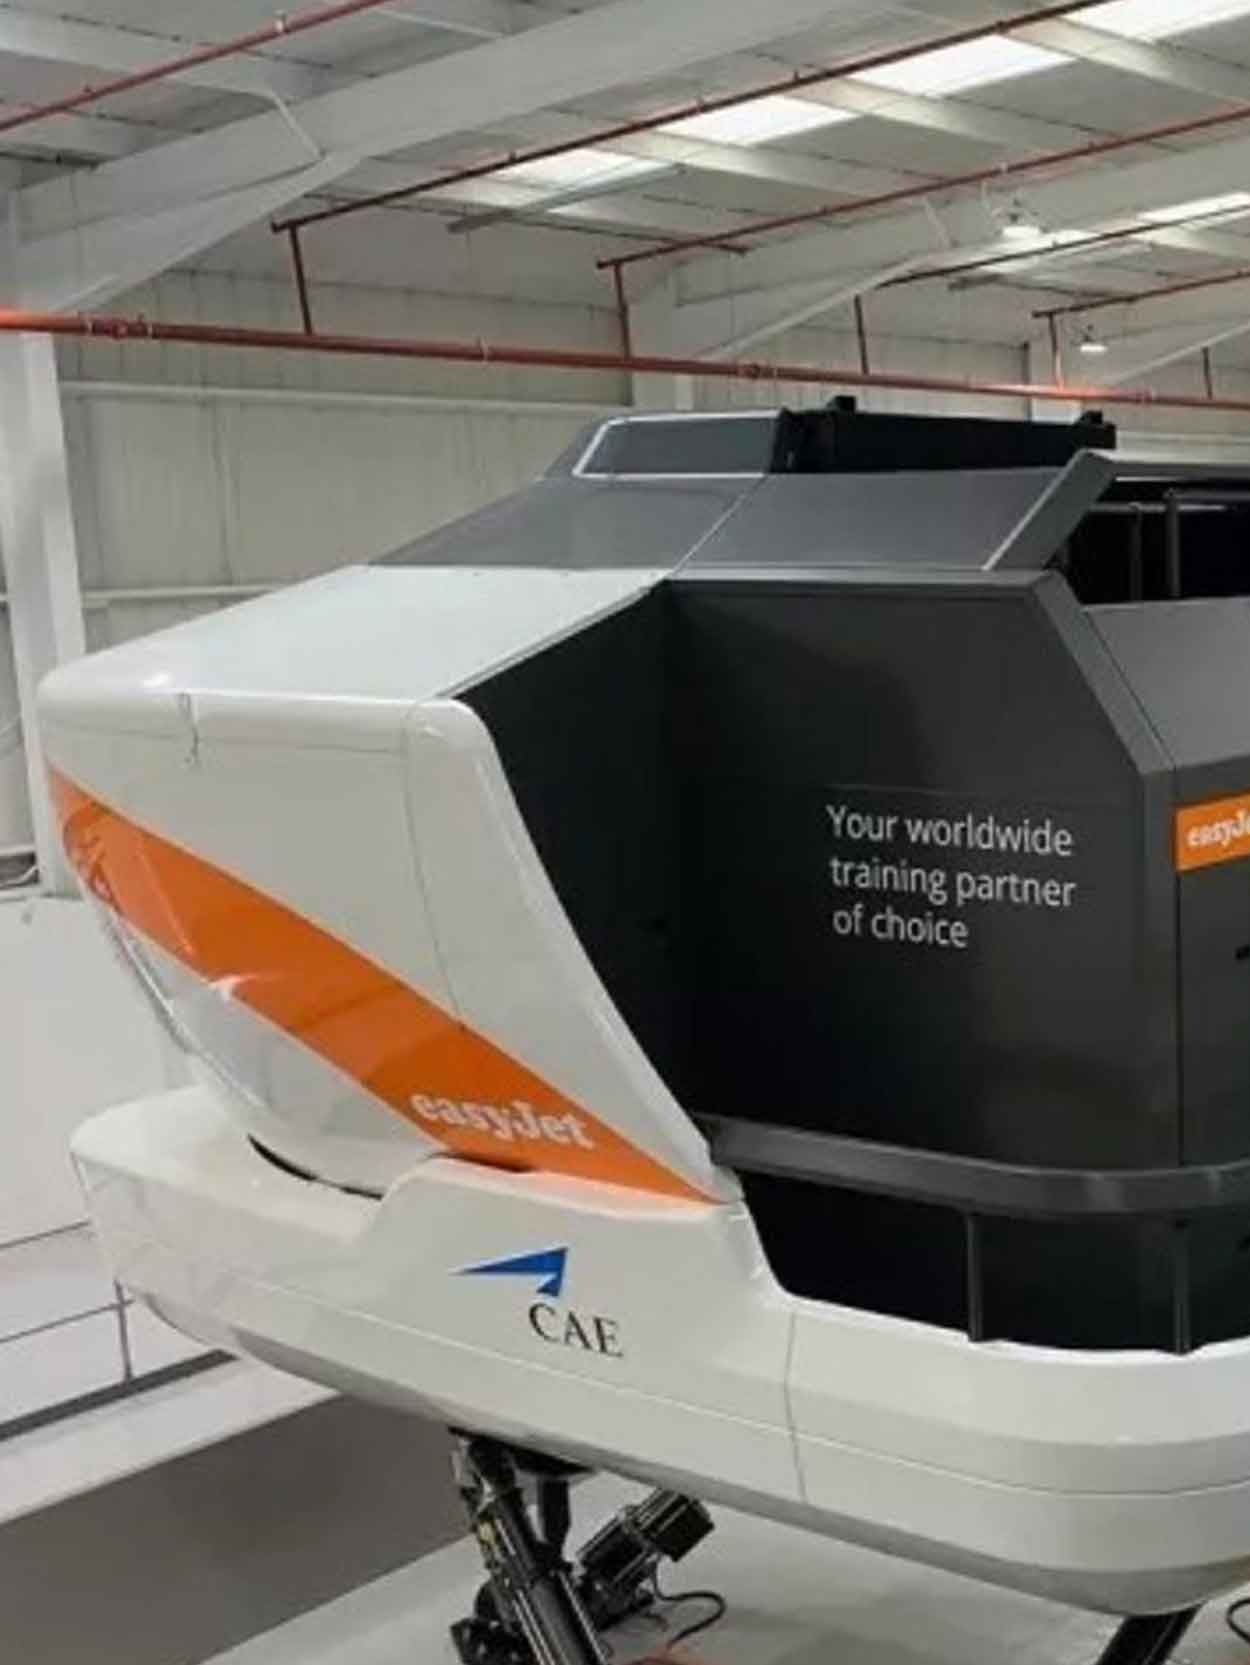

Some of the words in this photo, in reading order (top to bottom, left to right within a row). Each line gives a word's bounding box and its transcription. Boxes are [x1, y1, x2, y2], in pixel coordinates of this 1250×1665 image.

[825, 803, 898, 841] Your
[904, 812, 1073, 857] worldwide
[829, 856, 948, 906] training
[955, 870, 1077, 907] partner
[832, 903, 864, 936] of
[871, 905, 969, 948] choice
[409, 1092, 596, 1151] easyJet
[528, 1301, 624, 1359] CAE
